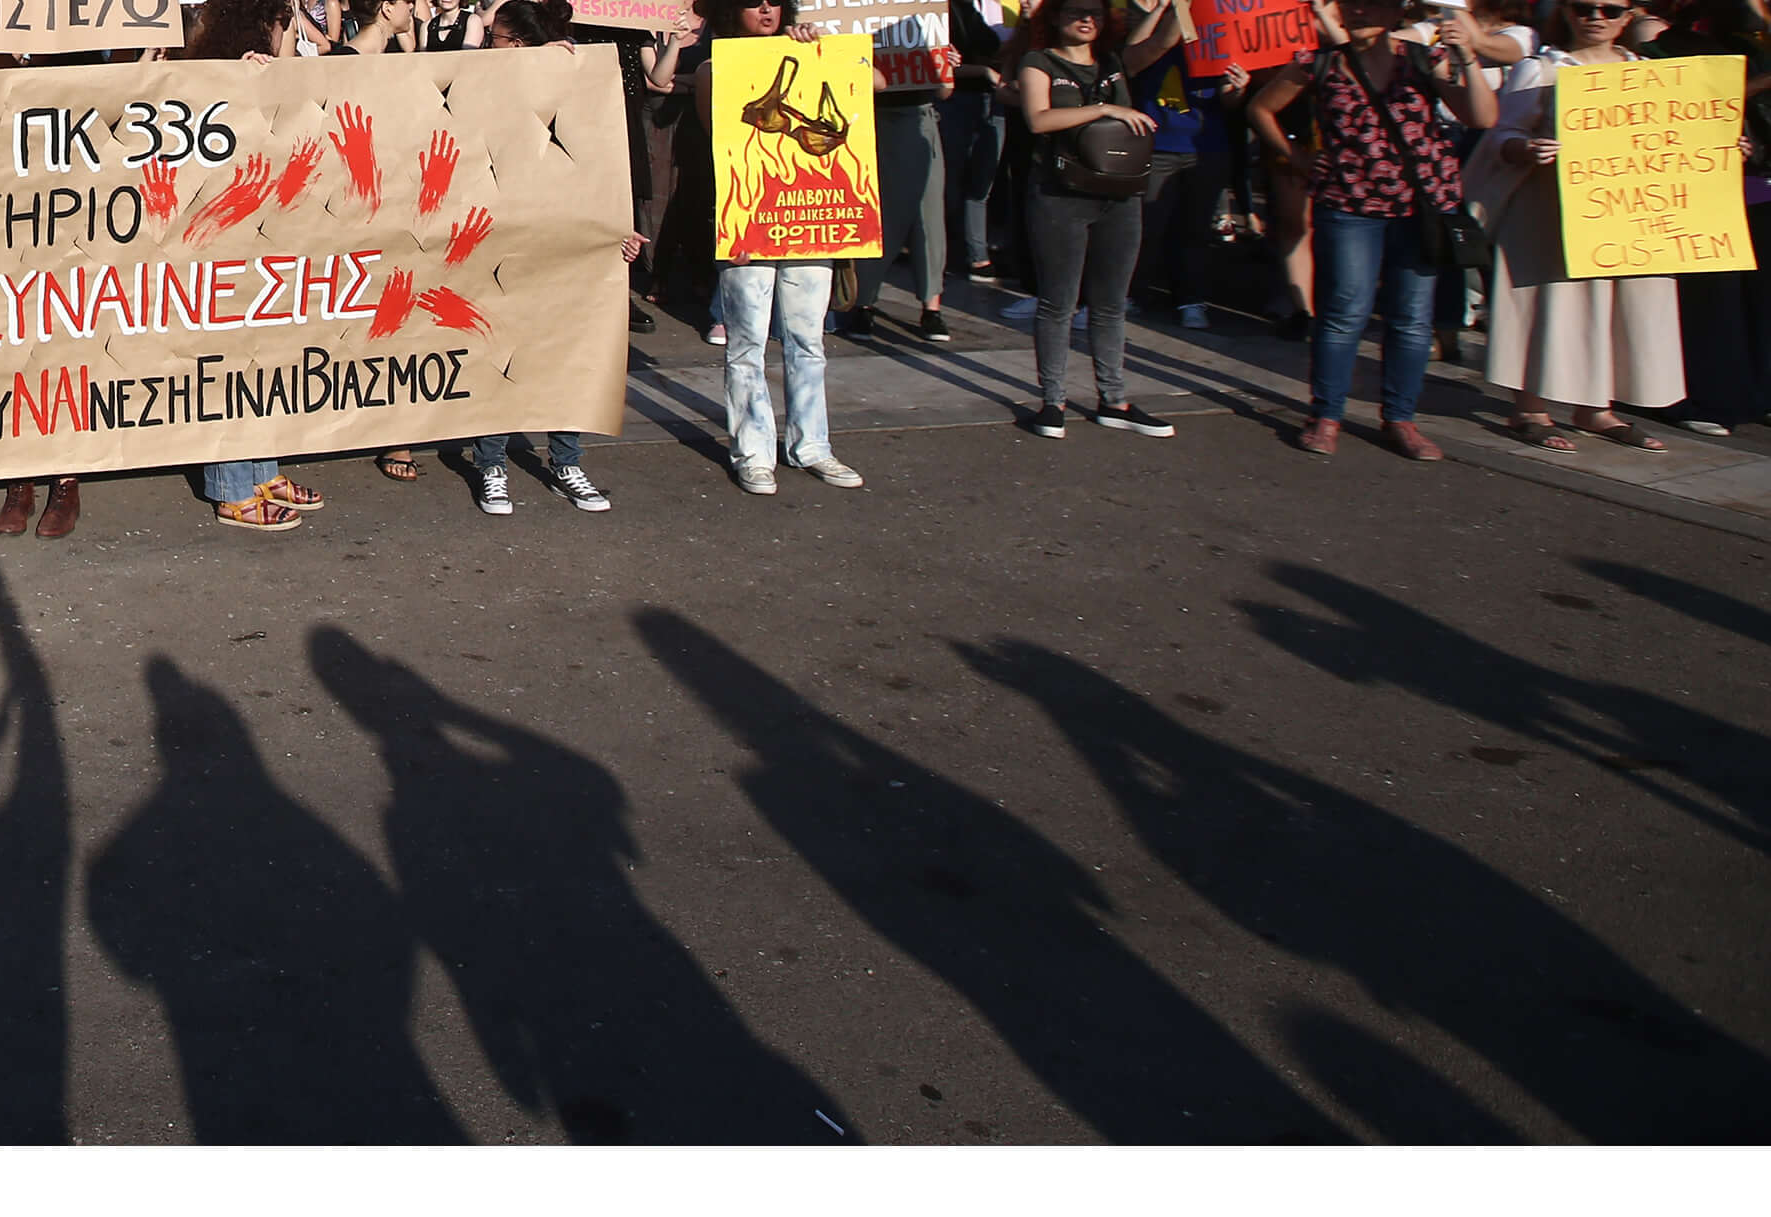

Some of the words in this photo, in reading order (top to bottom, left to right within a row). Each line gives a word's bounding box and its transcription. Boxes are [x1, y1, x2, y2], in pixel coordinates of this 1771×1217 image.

[852, 12, 950, 48] ΛΕΙΠΟΥΝ
[1234, 4, 1315, 53] WITCH
[1583, 71, 1607, 92] I
[1621, 65, 1688, 91] EAT
[1563, 102, 1659, 131] GENDER
[1667, 98, 1741, 122] ROLES
[13, 107, 101, 176] ΠΚ
[124, 100, 237, 169] 336
[1630, 130, 1682, 151] FOR
[1568, 145, 1738, 185] BREAKFAST
[776, 189, 845, 207] ΑΝΑΒΟΥΝ
[1582, 183, 1688, 219] SMASH
[758, 211, 778, 224] ΚΑΙ
[784, 209, 796, 223] ΟΙ
[799, 208, 834, 221] ΔΙΚΕΣ
[836, 207, 864, 219] ΜΑΣ
[1630, 214, 1685, 235] THE
[768, 224, 860, 246] ΦΩΤΙΕΣ
[1592, 233, 1736, 268] CIS-TEM
